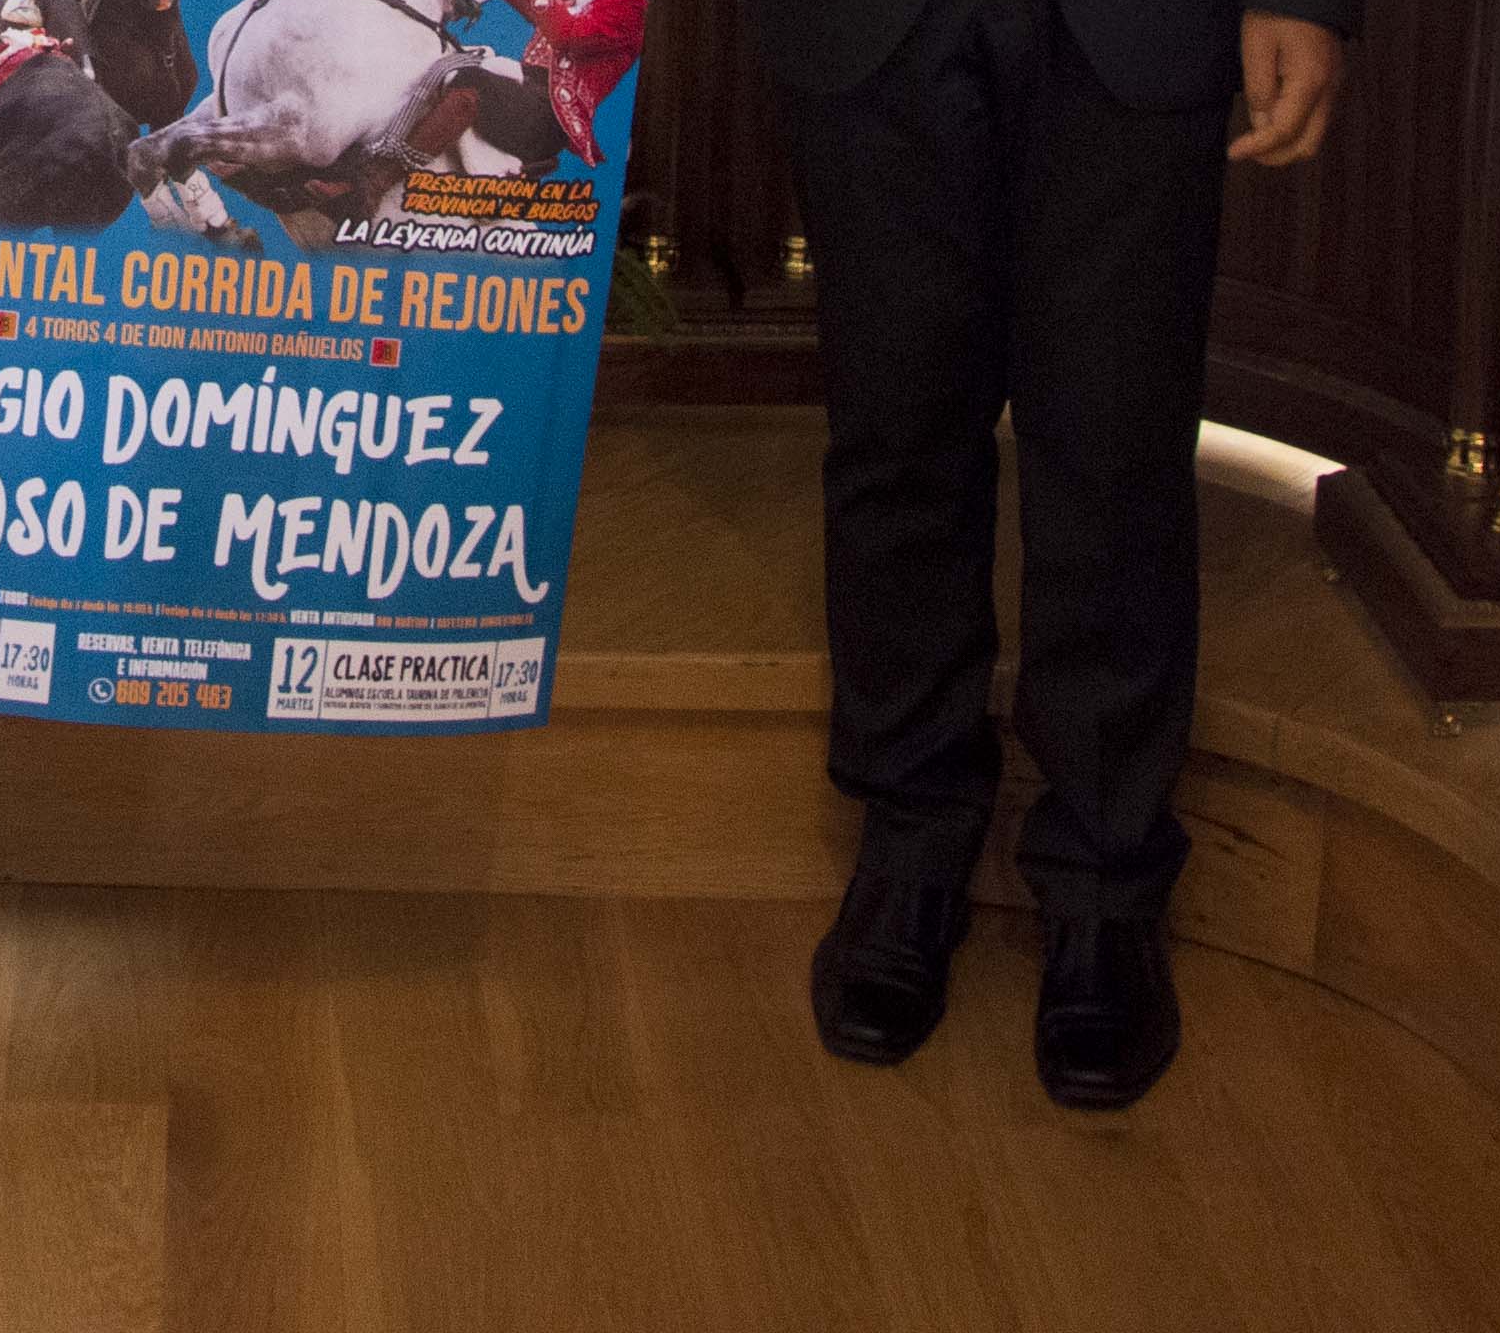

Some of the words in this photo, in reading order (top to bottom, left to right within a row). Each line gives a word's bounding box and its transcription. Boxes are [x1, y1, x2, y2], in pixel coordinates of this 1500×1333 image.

[407, 172, 535, 199] PRESENTACIÓN
[540, 182, 564, 199] EN
[569, 181, 592, 199] LA
[404, 193, 495, 215] PROVINCIA
[501, 203, 522, 216] DE
[527, 202, 598, 221] BURGOS
[336, 219, 369, 242] LA
[373, 221, 477, 250] LEYENDA
[484, 225, 595, 257] CONTINÚA
[121, 250, 313, 321] CORRIDA
[329, 265, 389, 325] DE
[400, 270, 590, 334] REJONES
[24, 316, 37, 338] 4
[43, 317, 100, 343] TOROS
[104, 322, 117, 344] 4
[120, 323, 144, 346] DE
[149, 325, 186, 349] DON
[189, 328, 267, 355] ANTONIO
[272, 330, 364, 361] BAÑUELOS
[103, 365, 503, 475] DOMÍNGUEZ
[103, 485, 182, 562] DE
[214, 492, 549, 604] MENDOZA
[1, 642, 49, 673] 17:30
[141, 636, 179, 656] VENTA
[116, 658, 126, 675] E
[277, 645, 318, 694] 12
[333, 654, 396, 681] CLASE
[400, 654, 488, 683] PRACTICA
[496, 660, 538, 688] 17:30
[7, 674, 39, 690] HORAS
[156, 682, 189, 707] 205
[276, 697, 314, 711] MARTES
